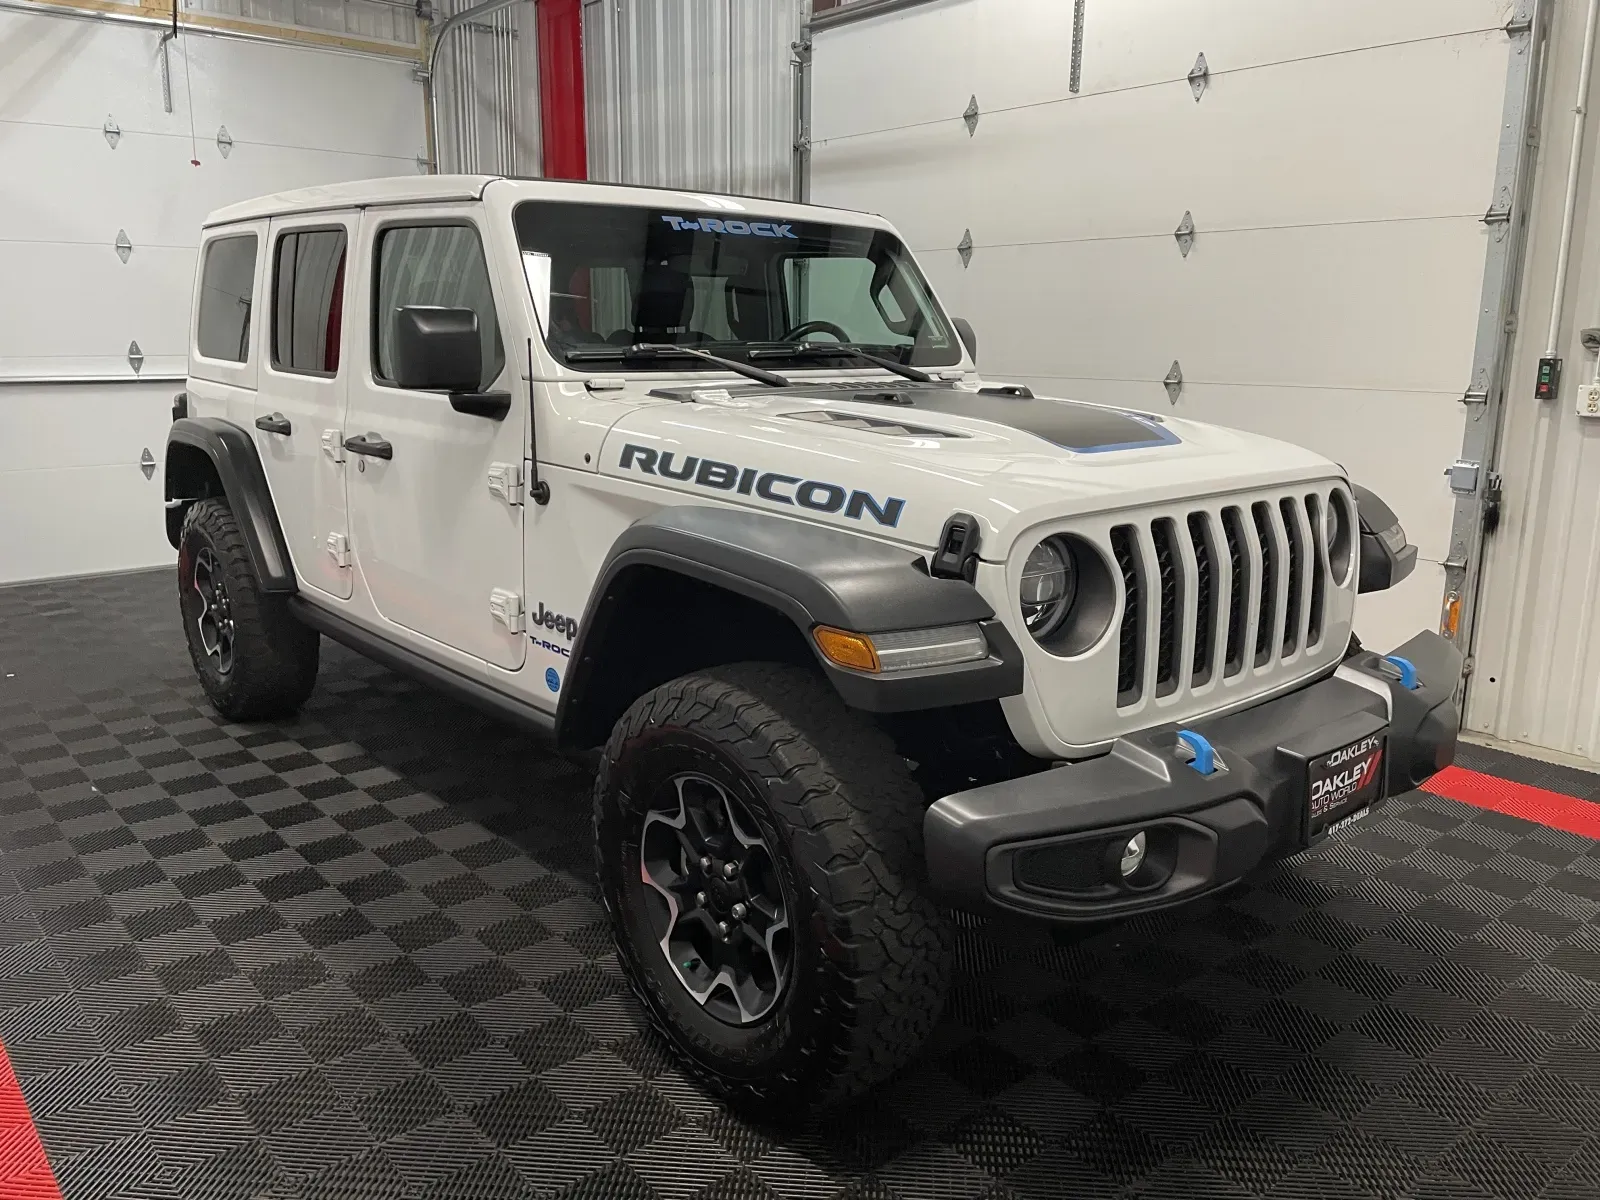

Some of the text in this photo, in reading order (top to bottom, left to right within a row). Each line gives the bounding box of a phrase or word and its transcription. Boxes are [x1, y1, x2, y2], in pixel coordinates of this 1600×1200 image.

[618, 443, 906, 528] RUBICON
[531, 601, 578, 641] Jeep
[1330, 736, 1376, 767] OAKLEY
[1311, 757, 1372, 801] OAKLEY
[1331, 781, 1358, 801] WORLD
